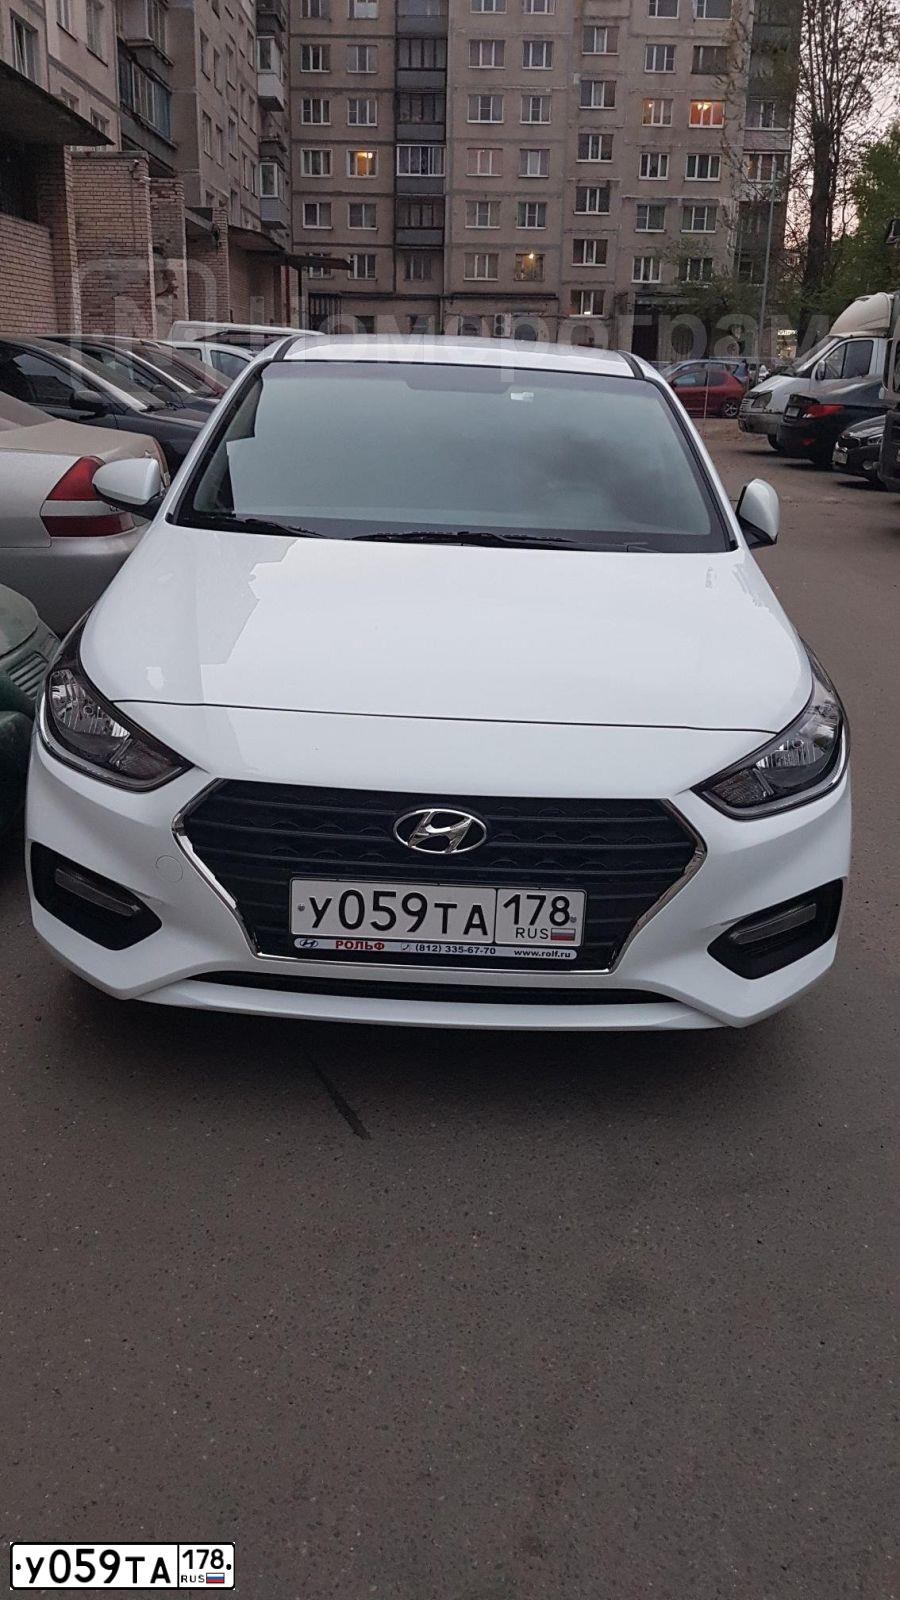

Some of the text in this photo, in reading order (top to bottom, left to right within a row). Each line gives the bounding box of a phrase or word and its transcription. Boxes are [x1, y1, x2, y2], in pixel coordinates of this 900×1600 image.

[308, 889, 571, 937] У059ТА 178
[515, 927, 549, 940] RUS
[335, 940, 572, 959] РОЛЬФ (812) 335-67-70 www.rolf.ru
